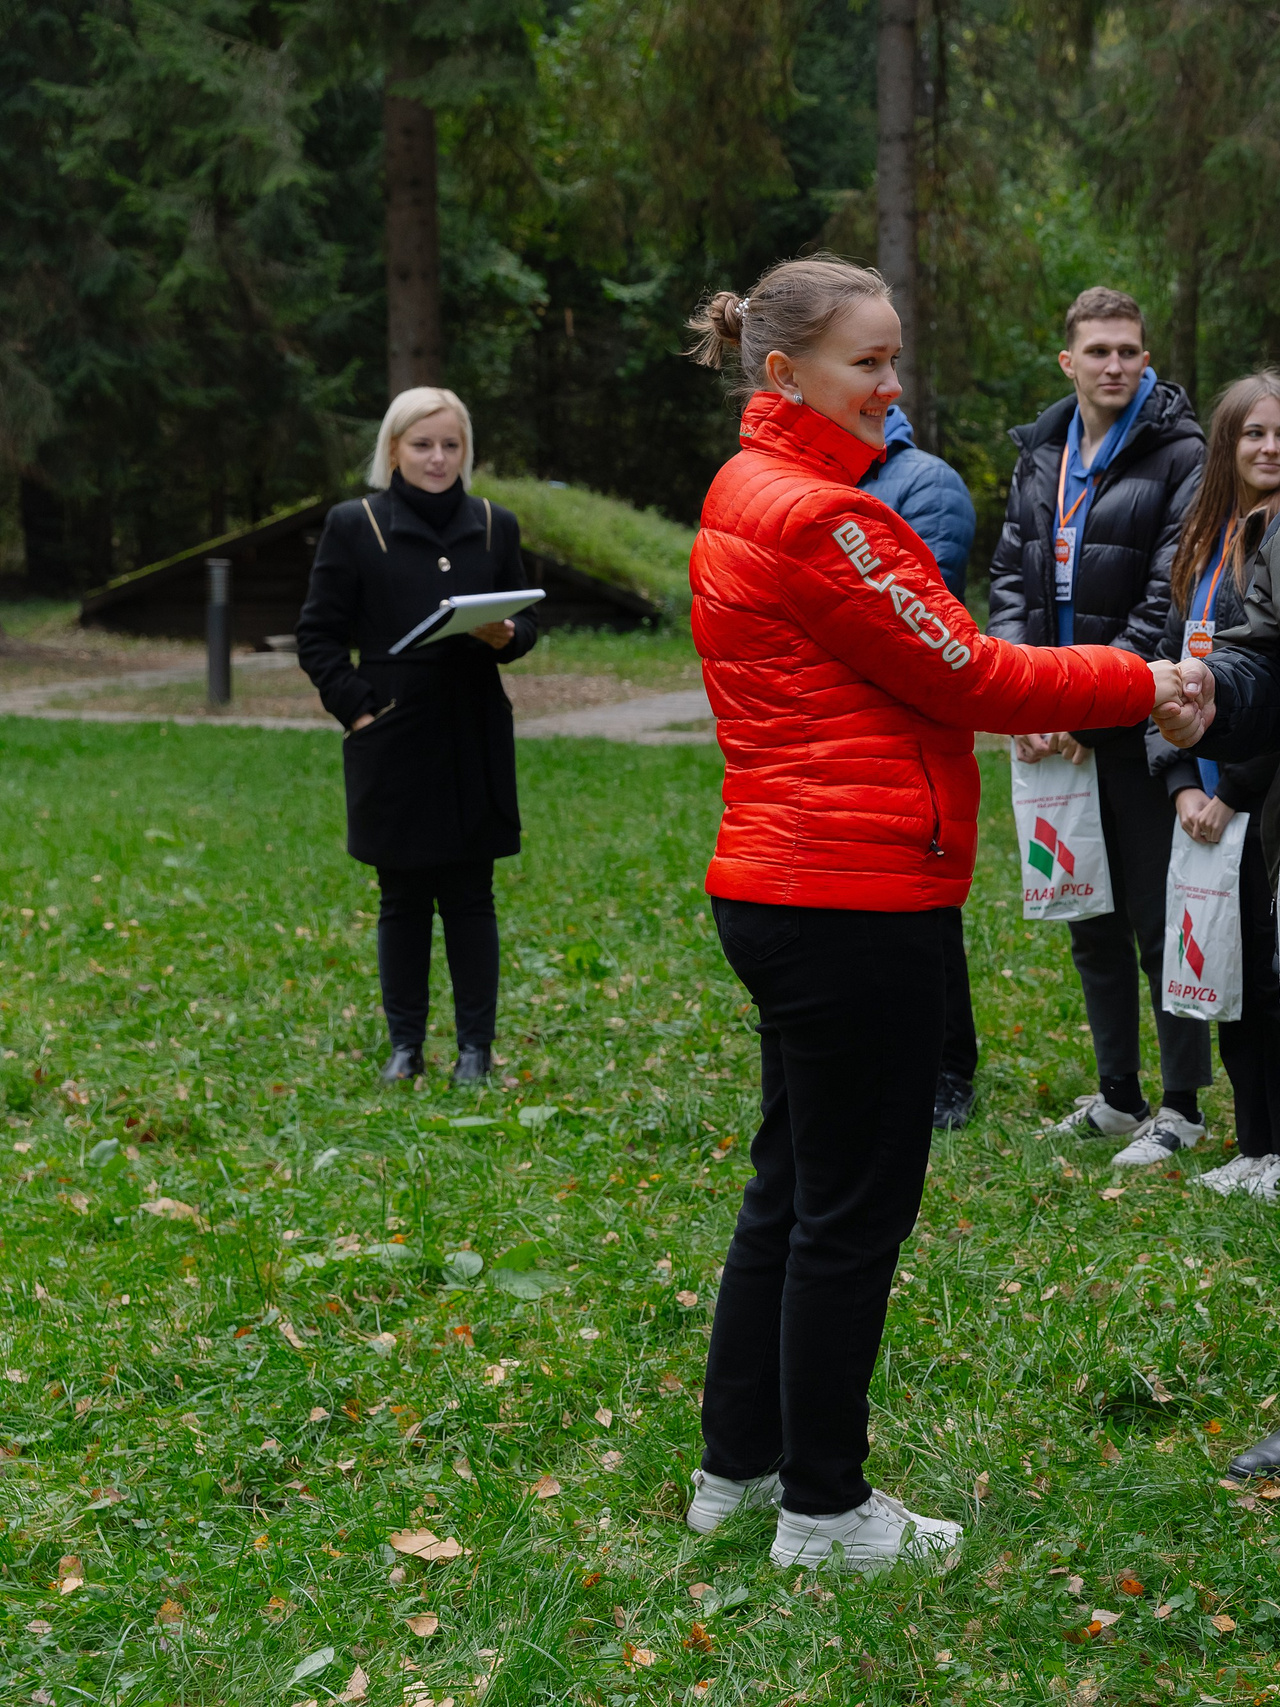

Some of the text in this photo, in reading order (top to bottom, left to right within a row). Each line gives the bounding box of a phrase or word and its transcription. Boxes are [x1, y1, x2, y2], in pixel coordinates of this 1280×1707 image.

[831, 520, 971, 670] BELARUS
[1061, 883, 1094, 897] РУСЬ
[1182, 985, 1218, 1002] РУСЬ
